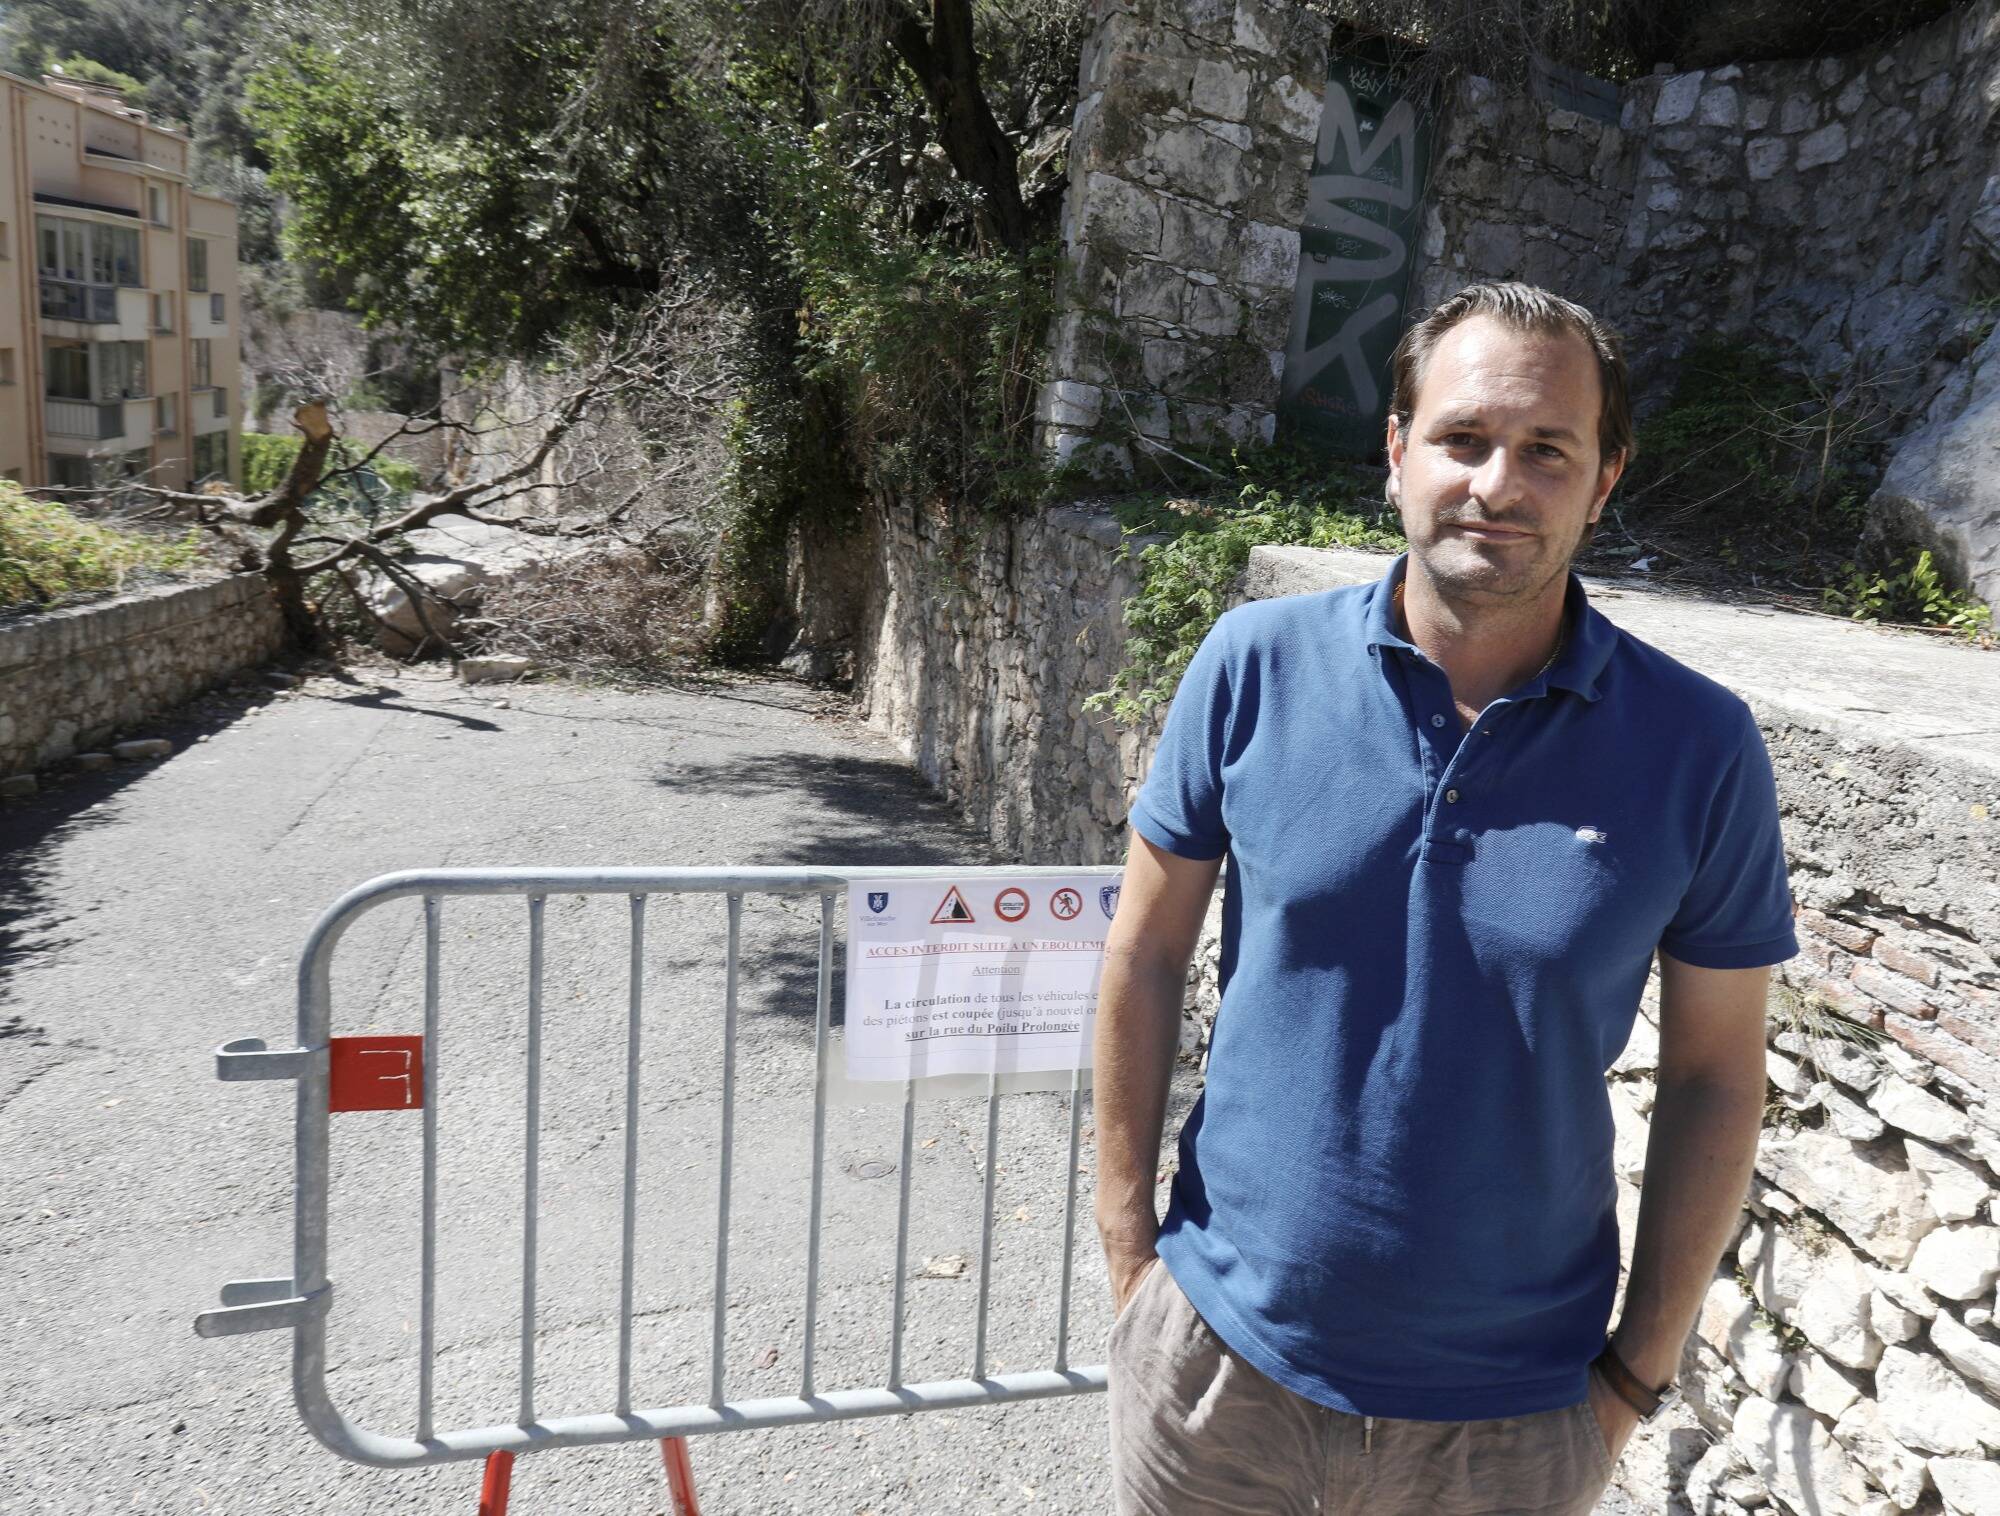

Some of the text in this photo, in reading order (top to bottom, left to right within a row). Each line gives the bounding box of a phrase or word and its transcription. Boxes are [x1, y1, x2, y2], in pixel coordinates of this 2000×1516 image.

[868, 946, 908, 956] ACCES
[911, 943, 968, 955] INTERDIT
[972, 942, 1006, 952] SUITE
[1011, 942, 1019, 951] A
[1022, 941, 1038, 951] UN
[971, 966, 1020, 975] Attention
[884, 999, 901, 1010] La
[905, 993, 970, 1009] circulation
[974, 992, 988, 1003] de
[992, 994, 1015, 1003] tous
[1019, 991, 1034, 1002] les
[1038, 990, 1090, 1001] véhicules
[863, 1015, 883, 1026] des
[886, 1013, 929, 1029] piétons
[932, 1011, 948, 1021] est
[952, 1007, 994, 1021] coupée
[1046, 1006, 1084, 1017] nouvel
[904, 1020, 1080, 1040] sur la rue du Poilu Prolongée
